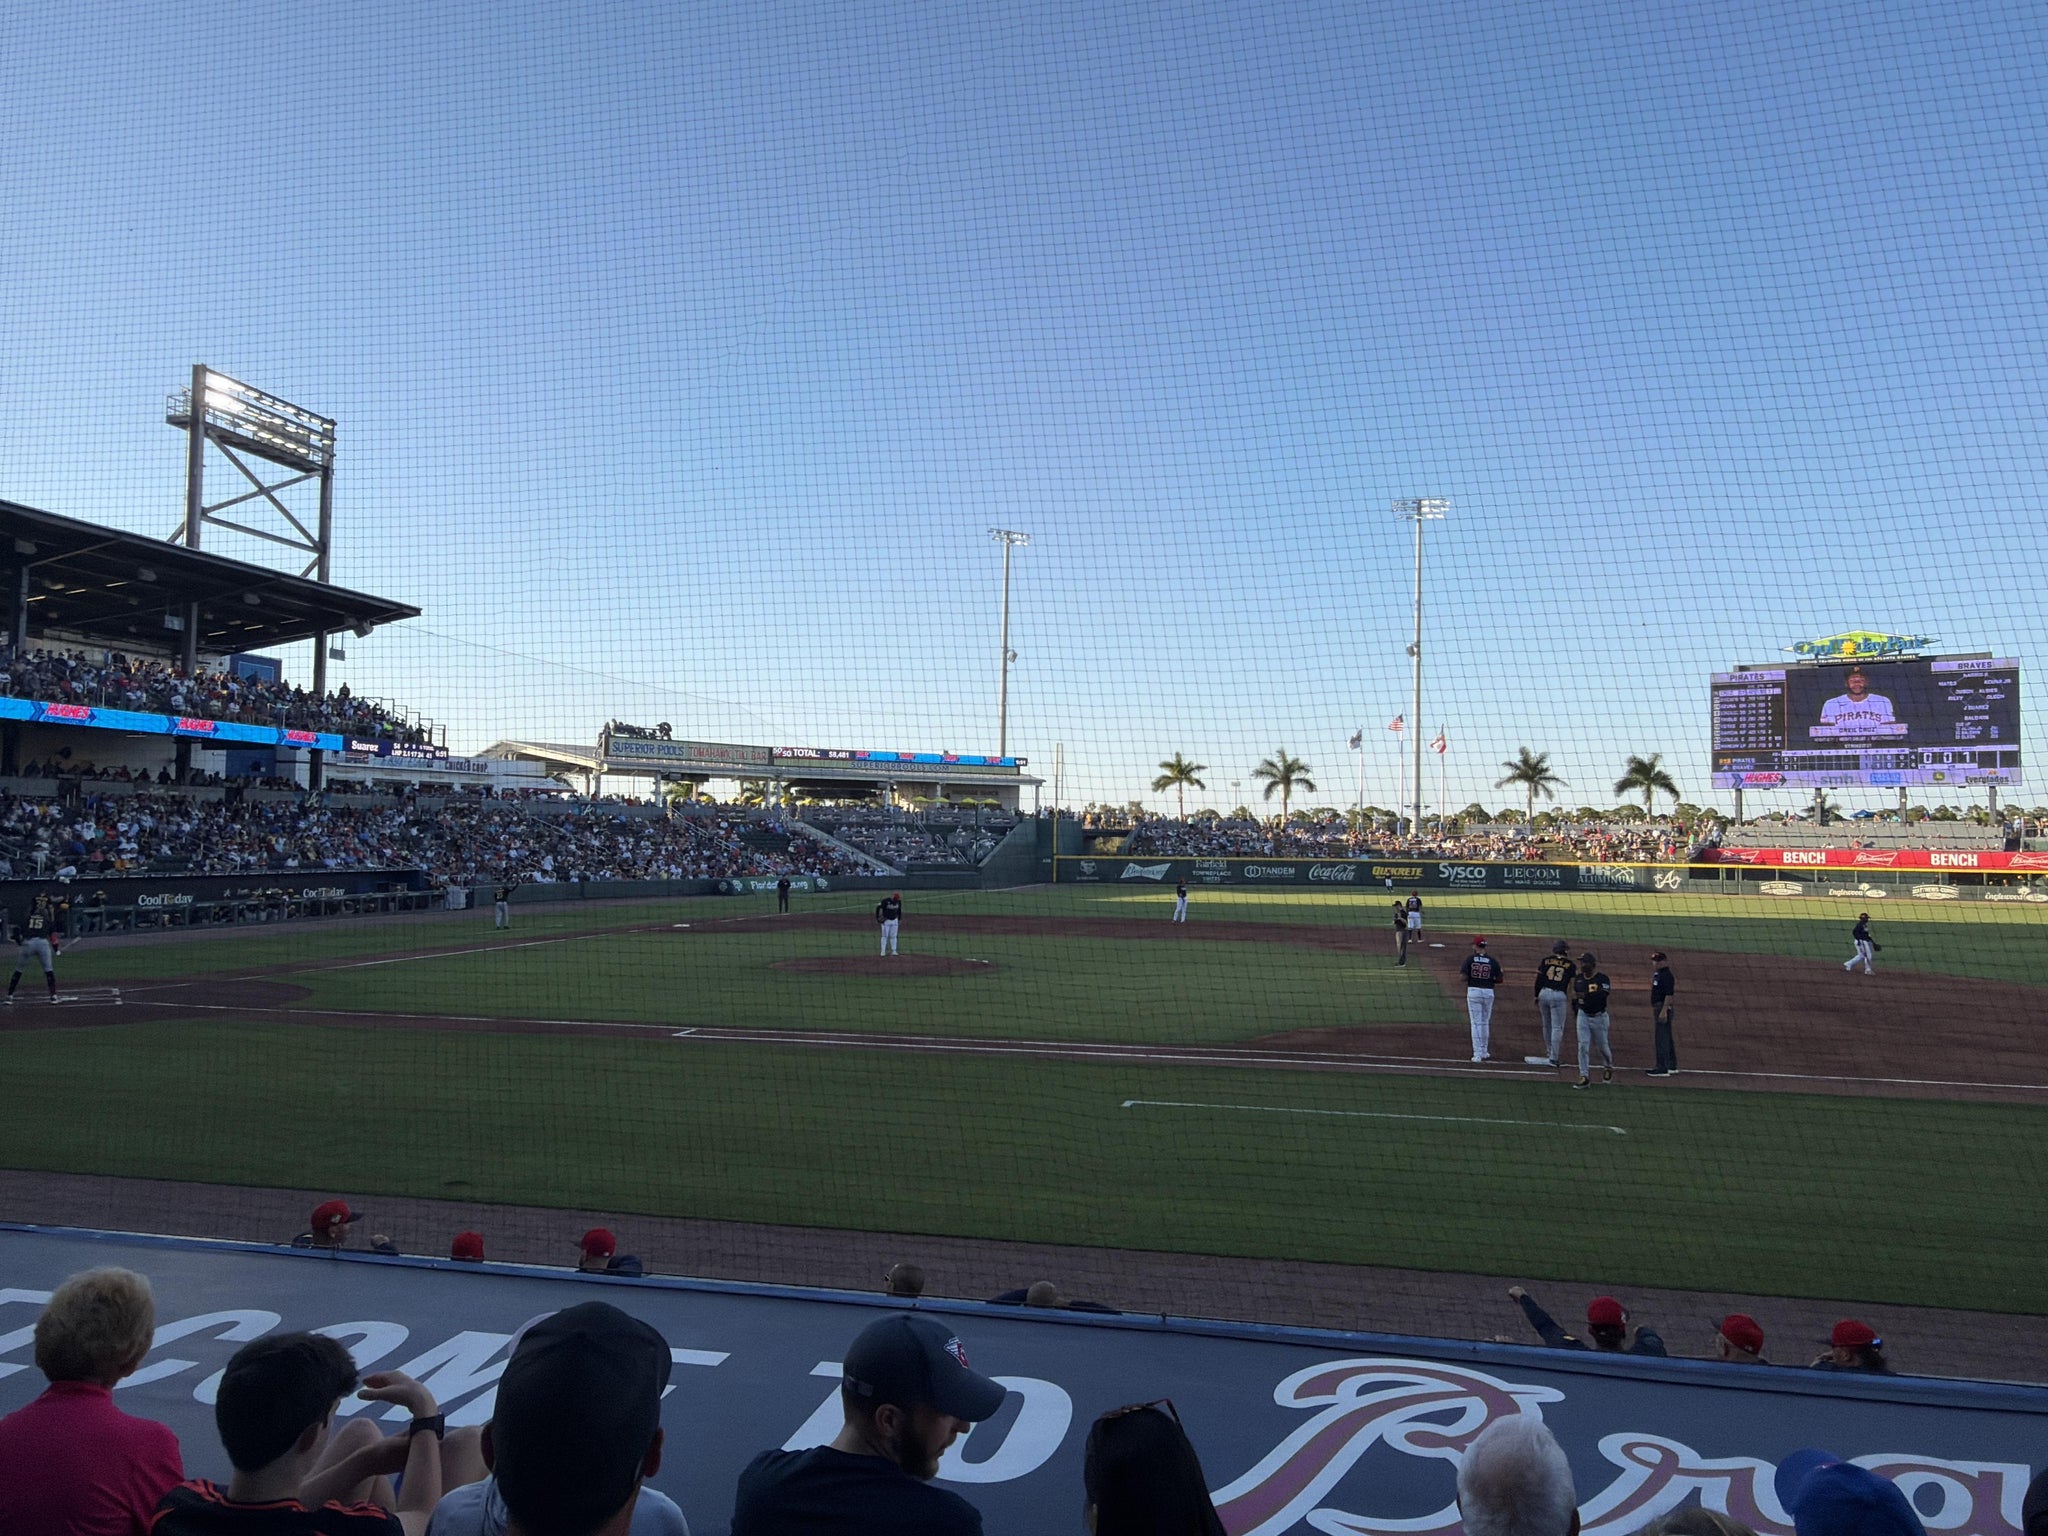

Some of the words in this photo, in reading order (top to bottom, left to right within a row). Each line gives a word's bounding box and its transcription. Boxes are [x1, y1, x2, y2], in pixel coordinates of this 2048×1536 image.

[1886, 635, 1927, 651] Park
[1957, 661, 1992, 669] BRAVES
[1729, 672, 1765, 681] PIRATES
[45, 703, 91, 719] HUGHES
[1834, 711, 1882, 724] PIRATES
[177, 717, 215, 732] HUGHES
[351, 740, 379, 752] Suarez
[612, 741, 655, 754] SUPERIOR
[658, 744, 685, 756] POOLS
[688, 746, 730, 760] TOMAHAWK
[734, 749, 748, 760] TIKI
[750, 750, 768, 761] BAR
[793, 748, 821, 758] TOTAL:
[1923, 752, 1932, 764] 0
[1943, 752, 1952, 764] 0
[1963, 752, 1970, 763] 1
[851, 761, 950, 771] SUPERIORPOOLS.COM
[1744, 773, 1781, 783] HUGHES
[1820, 774, 1854, 784] smh
[1965, 775, 2009, 784] Everglades
[1195, 860, 1227, 868] Fairfield
[1783, 852, 1826, 864] BENCH
[1930, 854, 1978, 867] BENCH
[1308, 863, 1357, 881] Coca-Cola
[1439, 863, 1486, 881] Sysco
[1578, 875, 1635, 884] ALUMINUM
[138, 893, 194, 906] CoolToday
[1985, 892, 2023, 901] Englewood
[28, 918, 44, 929] 15
[1470, 963, 1492, 979] 28
[1546, 965, 1565, 982] 43
